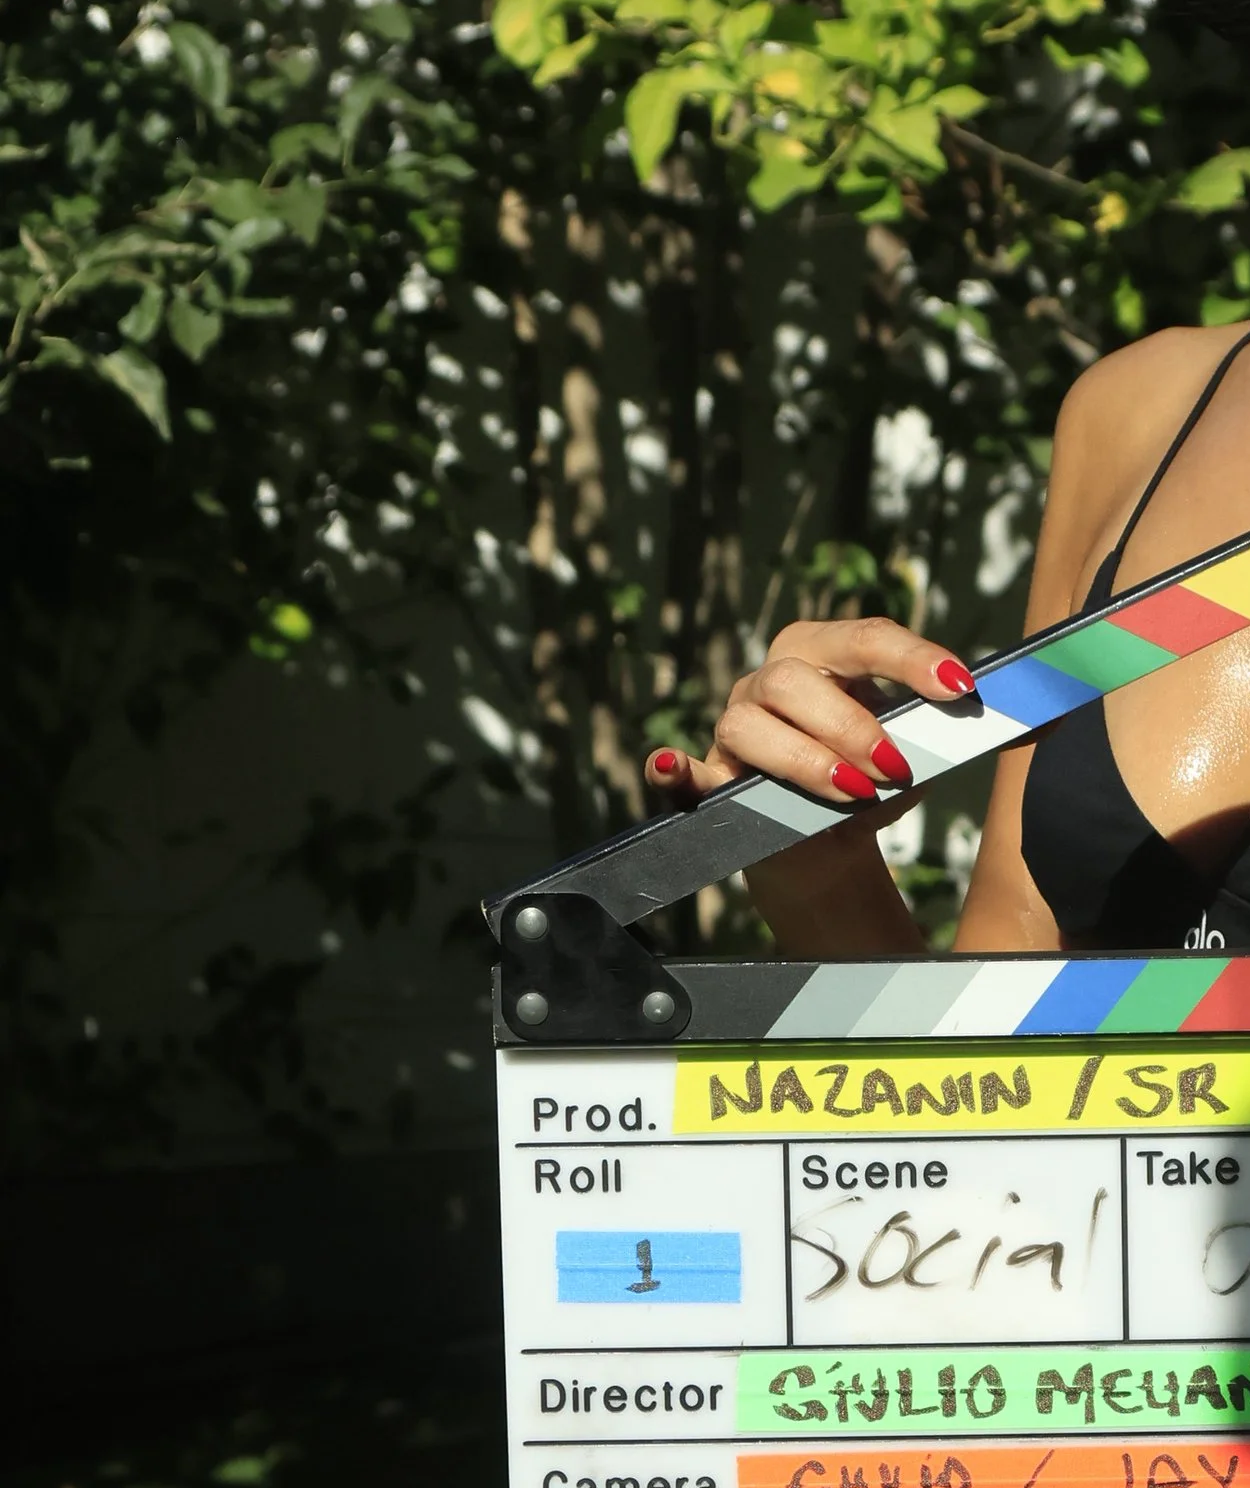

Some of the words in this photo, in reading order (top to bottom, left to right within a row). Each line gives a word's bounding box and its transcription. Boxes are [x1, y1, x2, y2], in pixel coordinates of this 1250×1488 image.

[1184, 909, 1226, 950] alo
[708, 1057, 1033, 1122] NAZANIN
[1115, 1062, 1231, 1119] SR
[532, 1097, 658, 1133] Prod.
[533, 1158, 623, 1194] Roll
[801, 1154, 949, 1191] Scene
[1135, 1150, 1241, 1186] Take
[624, 1238, 662, 1294] 1
[539, 1378, 724, 1414] Director
